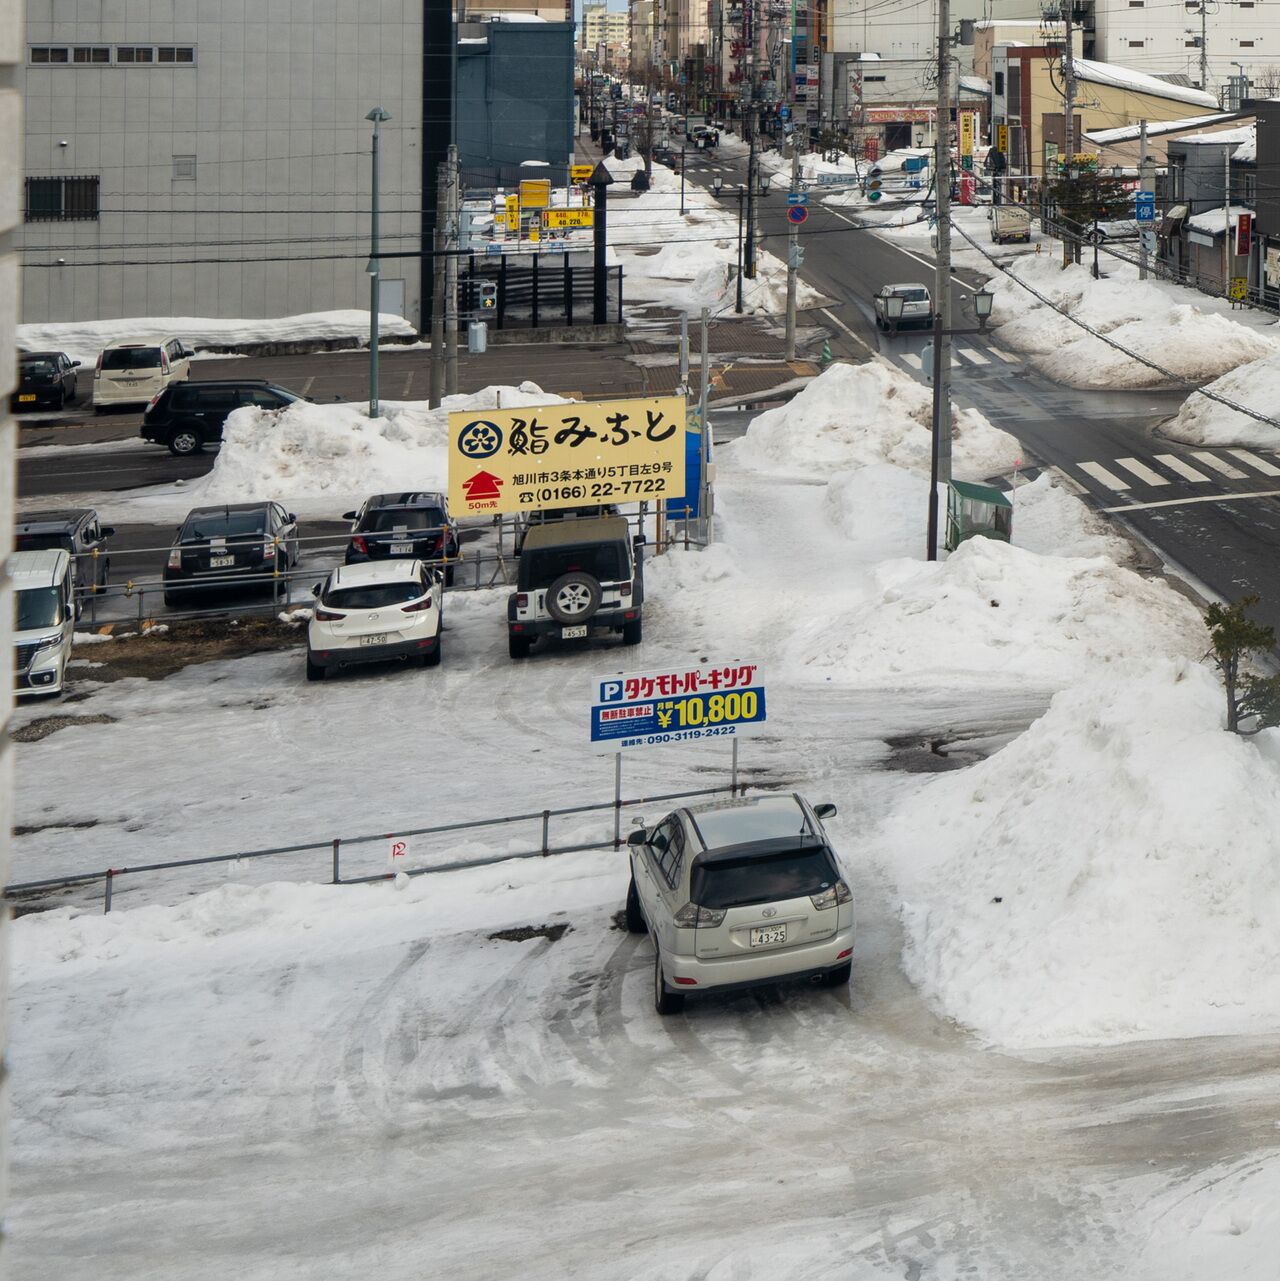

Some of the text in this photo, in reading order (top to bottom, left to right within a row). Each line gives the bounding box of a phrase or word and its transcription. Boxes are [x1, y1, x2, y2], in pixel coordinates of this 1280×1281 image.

[512, 461, 674, 486] 旭川市3条本通り5丁目左9号
[536, 478, 666, 503] (0166) 22-7722
[468, 501, 498, 510] 50m先
[604, 683, 619, 700] P
[624, 665, 757, 699] タケモトパーキング
[657, 691, 757, 729] ¥10,800
